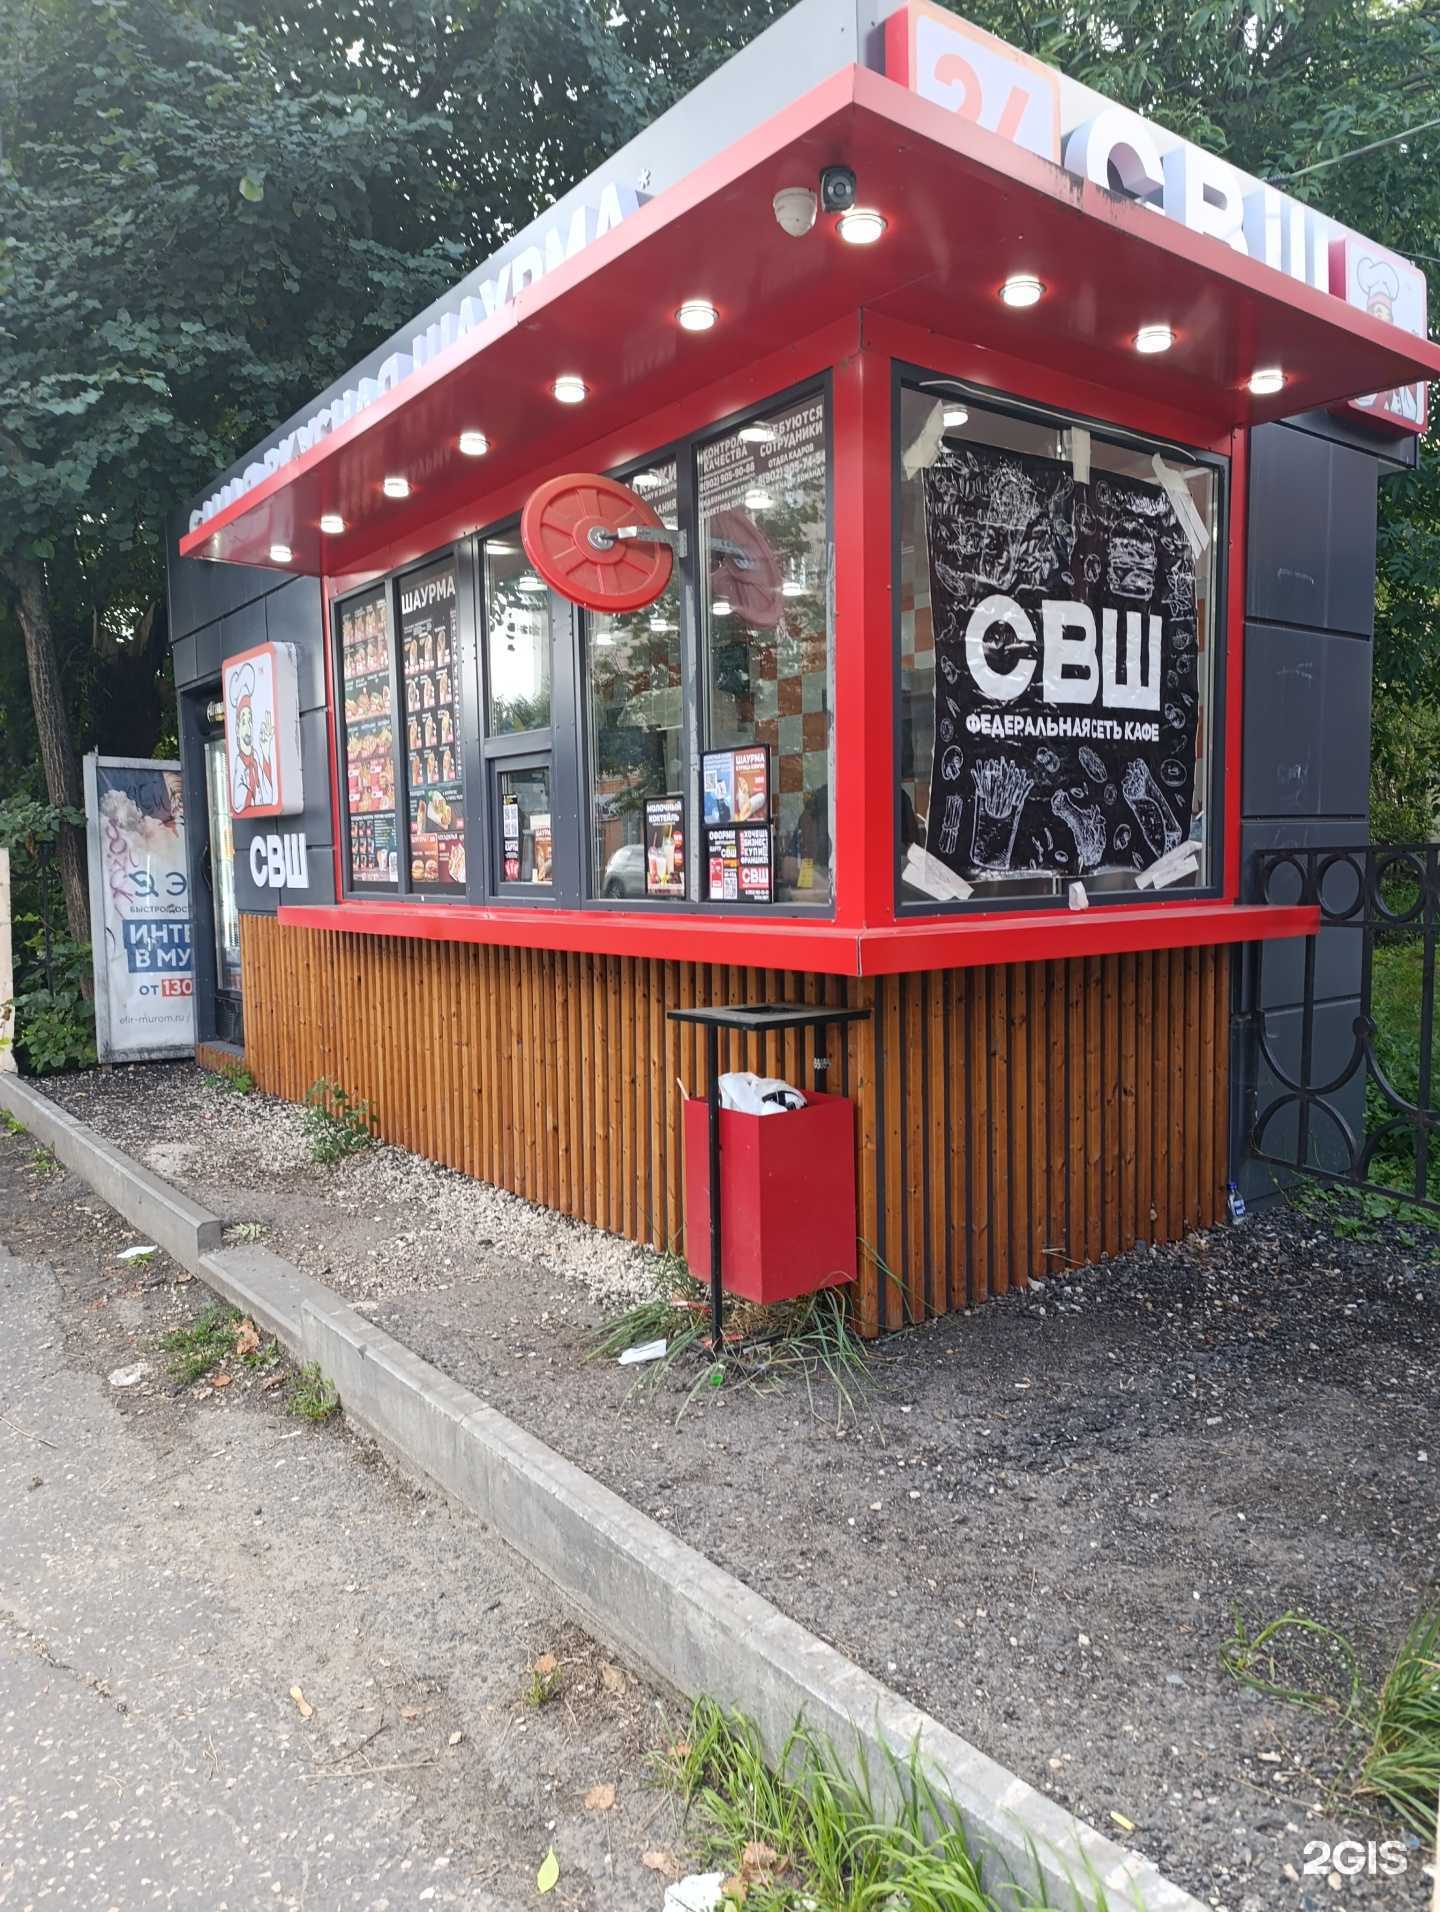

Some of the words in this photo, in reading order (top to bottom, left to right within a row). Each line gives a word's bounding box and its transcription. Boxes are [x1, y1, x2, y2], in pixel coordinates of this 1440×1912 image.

[1065, 108, 1330, 294] СВШ
[766, 405, 824, 437] ЕБУЮТСЯ
[703, 437, 746, 461] КОНТРОЛ
[760, 420, 824, 457] СОТРУДНИКИ
[703, 446, 749, 473] КАЧЕСТВА
[401, 576, 456, 614] ШАУРМА
[965, 594, 1163, 711] СВШ
[965, 713, 1091, 739] ФЕДЕРАЛЬНАЯ
[1091, 719, 1123, 742] СЕТЬ
[1124, 721, 1160, 742] КАФЕ
[250, 832, 309, 889] СВШ
[742, 868, 768, 884] СВШ
[135, 948, 151, 968] В
